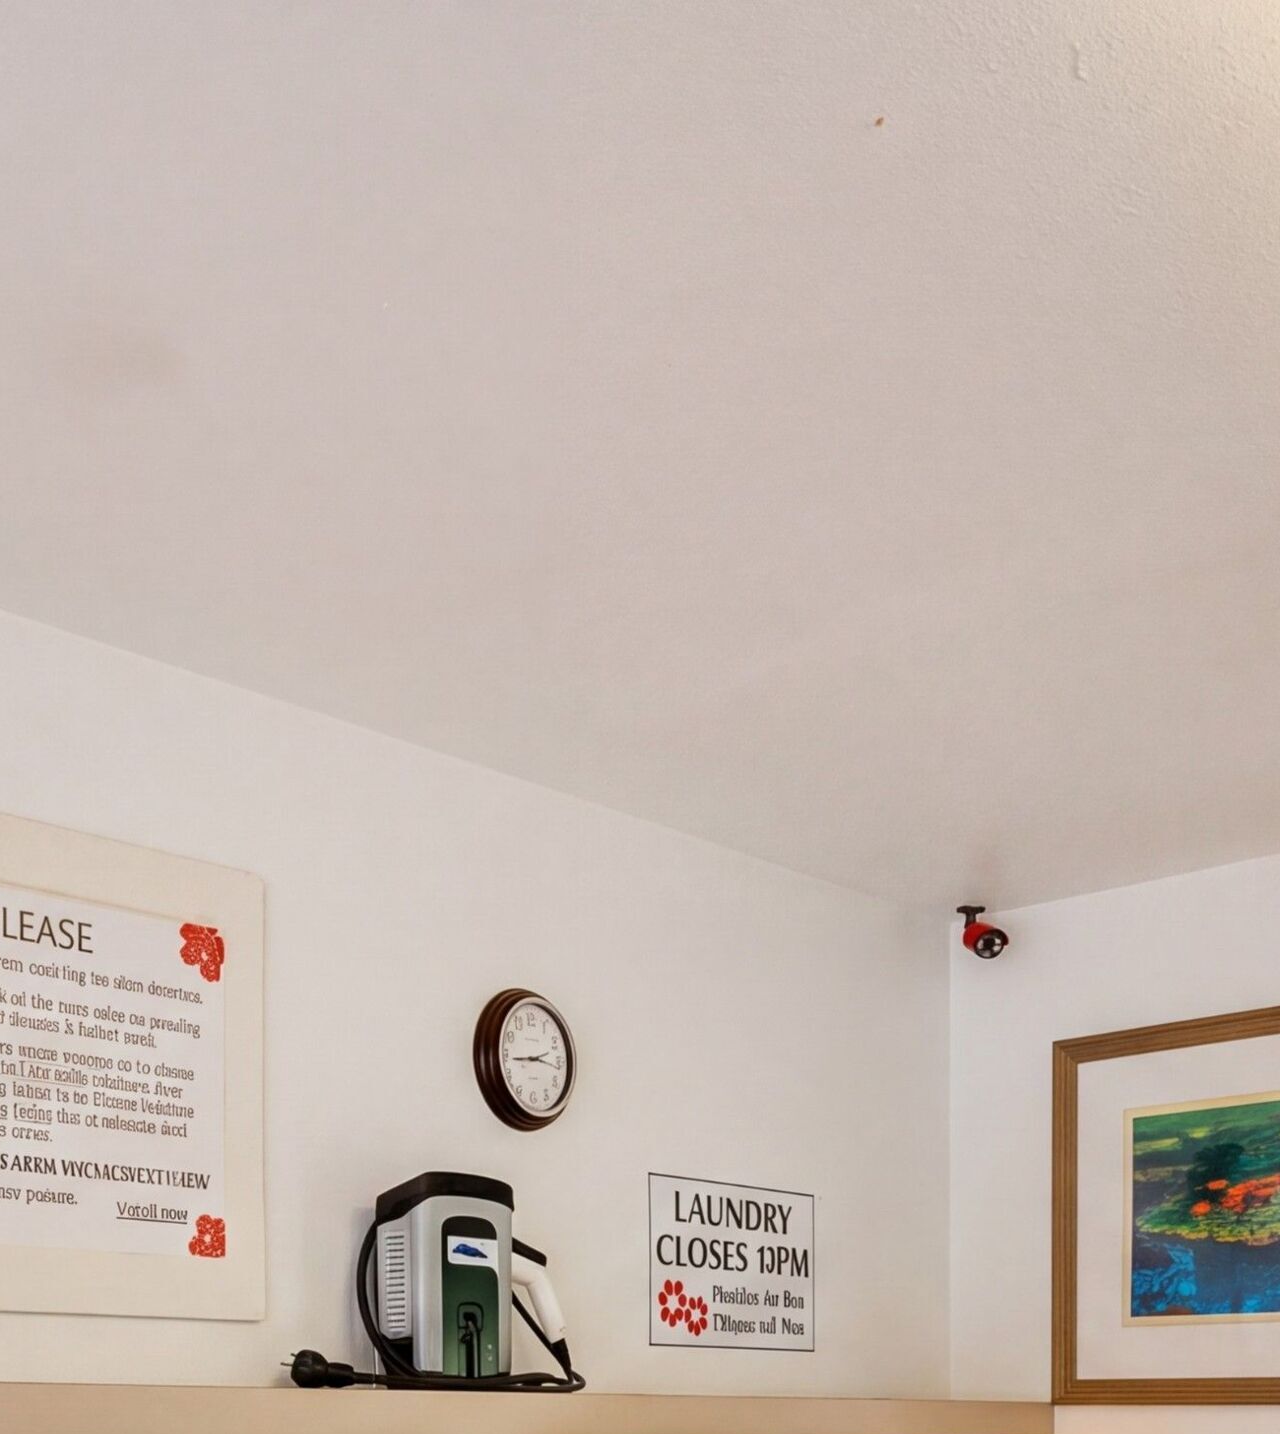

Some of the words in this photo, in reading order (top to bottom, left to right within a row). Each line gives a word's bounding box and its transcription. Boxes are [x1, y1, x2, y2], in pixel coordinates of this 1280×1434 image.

[31, 994, 53, 1012] the
[675, 1190, 792, 1235] LAUNDRY
[656, 1234, 748, 1272] CLOSES
